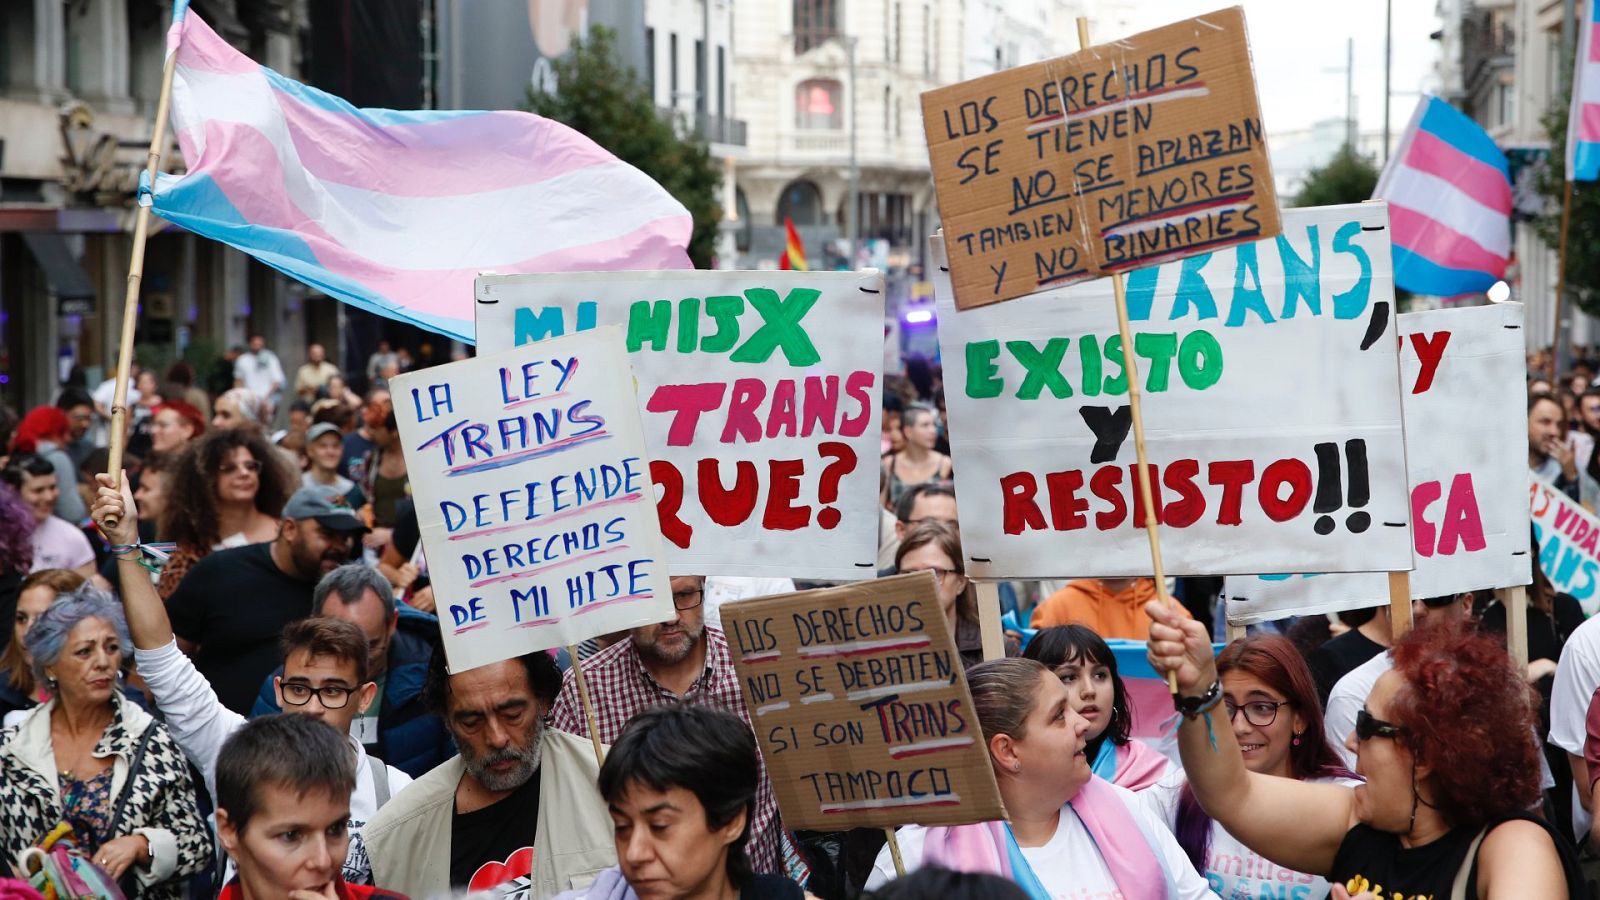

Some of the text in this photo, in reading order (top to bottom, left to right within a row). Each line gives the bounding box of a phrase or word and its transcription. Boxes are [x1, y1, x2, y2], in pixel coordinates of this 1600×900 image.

[944, 47, 1201, 140] LOS DERECHOS
[957, 103, 1153, 185] SE TIENEN
[1012, 117, 1265, 211] NO SE APLAZAN
[958, 165, 1255, 256] TAMBIEN MENORES
[990, 205, 1261, 294] Y NO BINARIES
[514, 287, 823, 367] MI HIJX
[410, 357, 579, 423] LA LEY
[965, 330, 1224, 400] EXISTO
[417, 400, 605, 466] TRANS
[646, 371, 875, 446] TRANS
[1079, 405, 1133, 463] Y
[439, 457, 642, 533] DEFIENDE
[649, 442, 858, 549] QUE?
[1000, 438, 1371, 535] RESISTO!!
[462, 517, 626, 580] DERECHOS
[1553, 501, 1600, 562] VIDA
[450, 560, 653, 627] DE MI HIJE
[733, 601, 925, 654] LOS DERECHOS
[747, 650, 957, 705] NO SE DEBATEN,
[769, 694, 966, 754] SI SON TRANS
[801, 768, 951, 802] TAMPOCO
